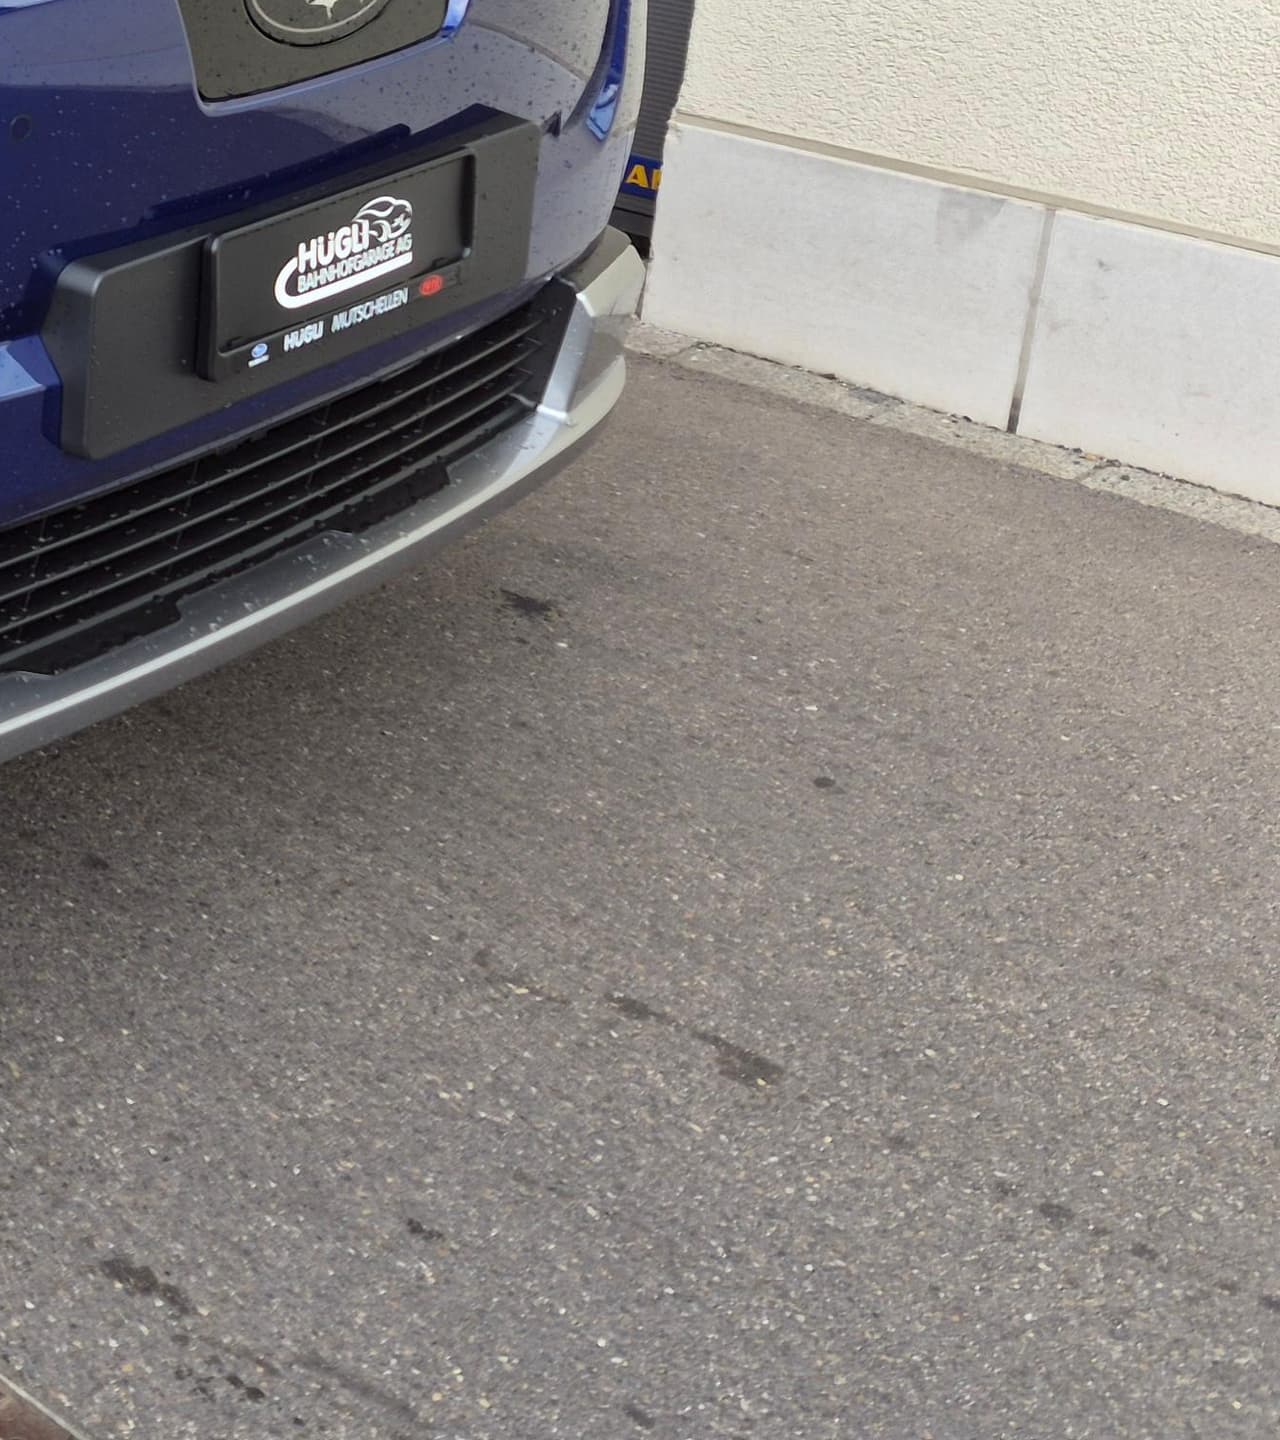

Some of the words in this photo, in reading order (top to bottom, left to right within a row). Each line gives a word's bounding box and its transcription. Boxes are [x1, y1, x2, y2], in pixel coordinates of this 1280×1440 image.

[297, 242, 396, 293] BAHNHOFGARAGE
[298, 219, 370, 273] HÜGLI
[331, 288, 409, 333] MUTSCHELLEN
